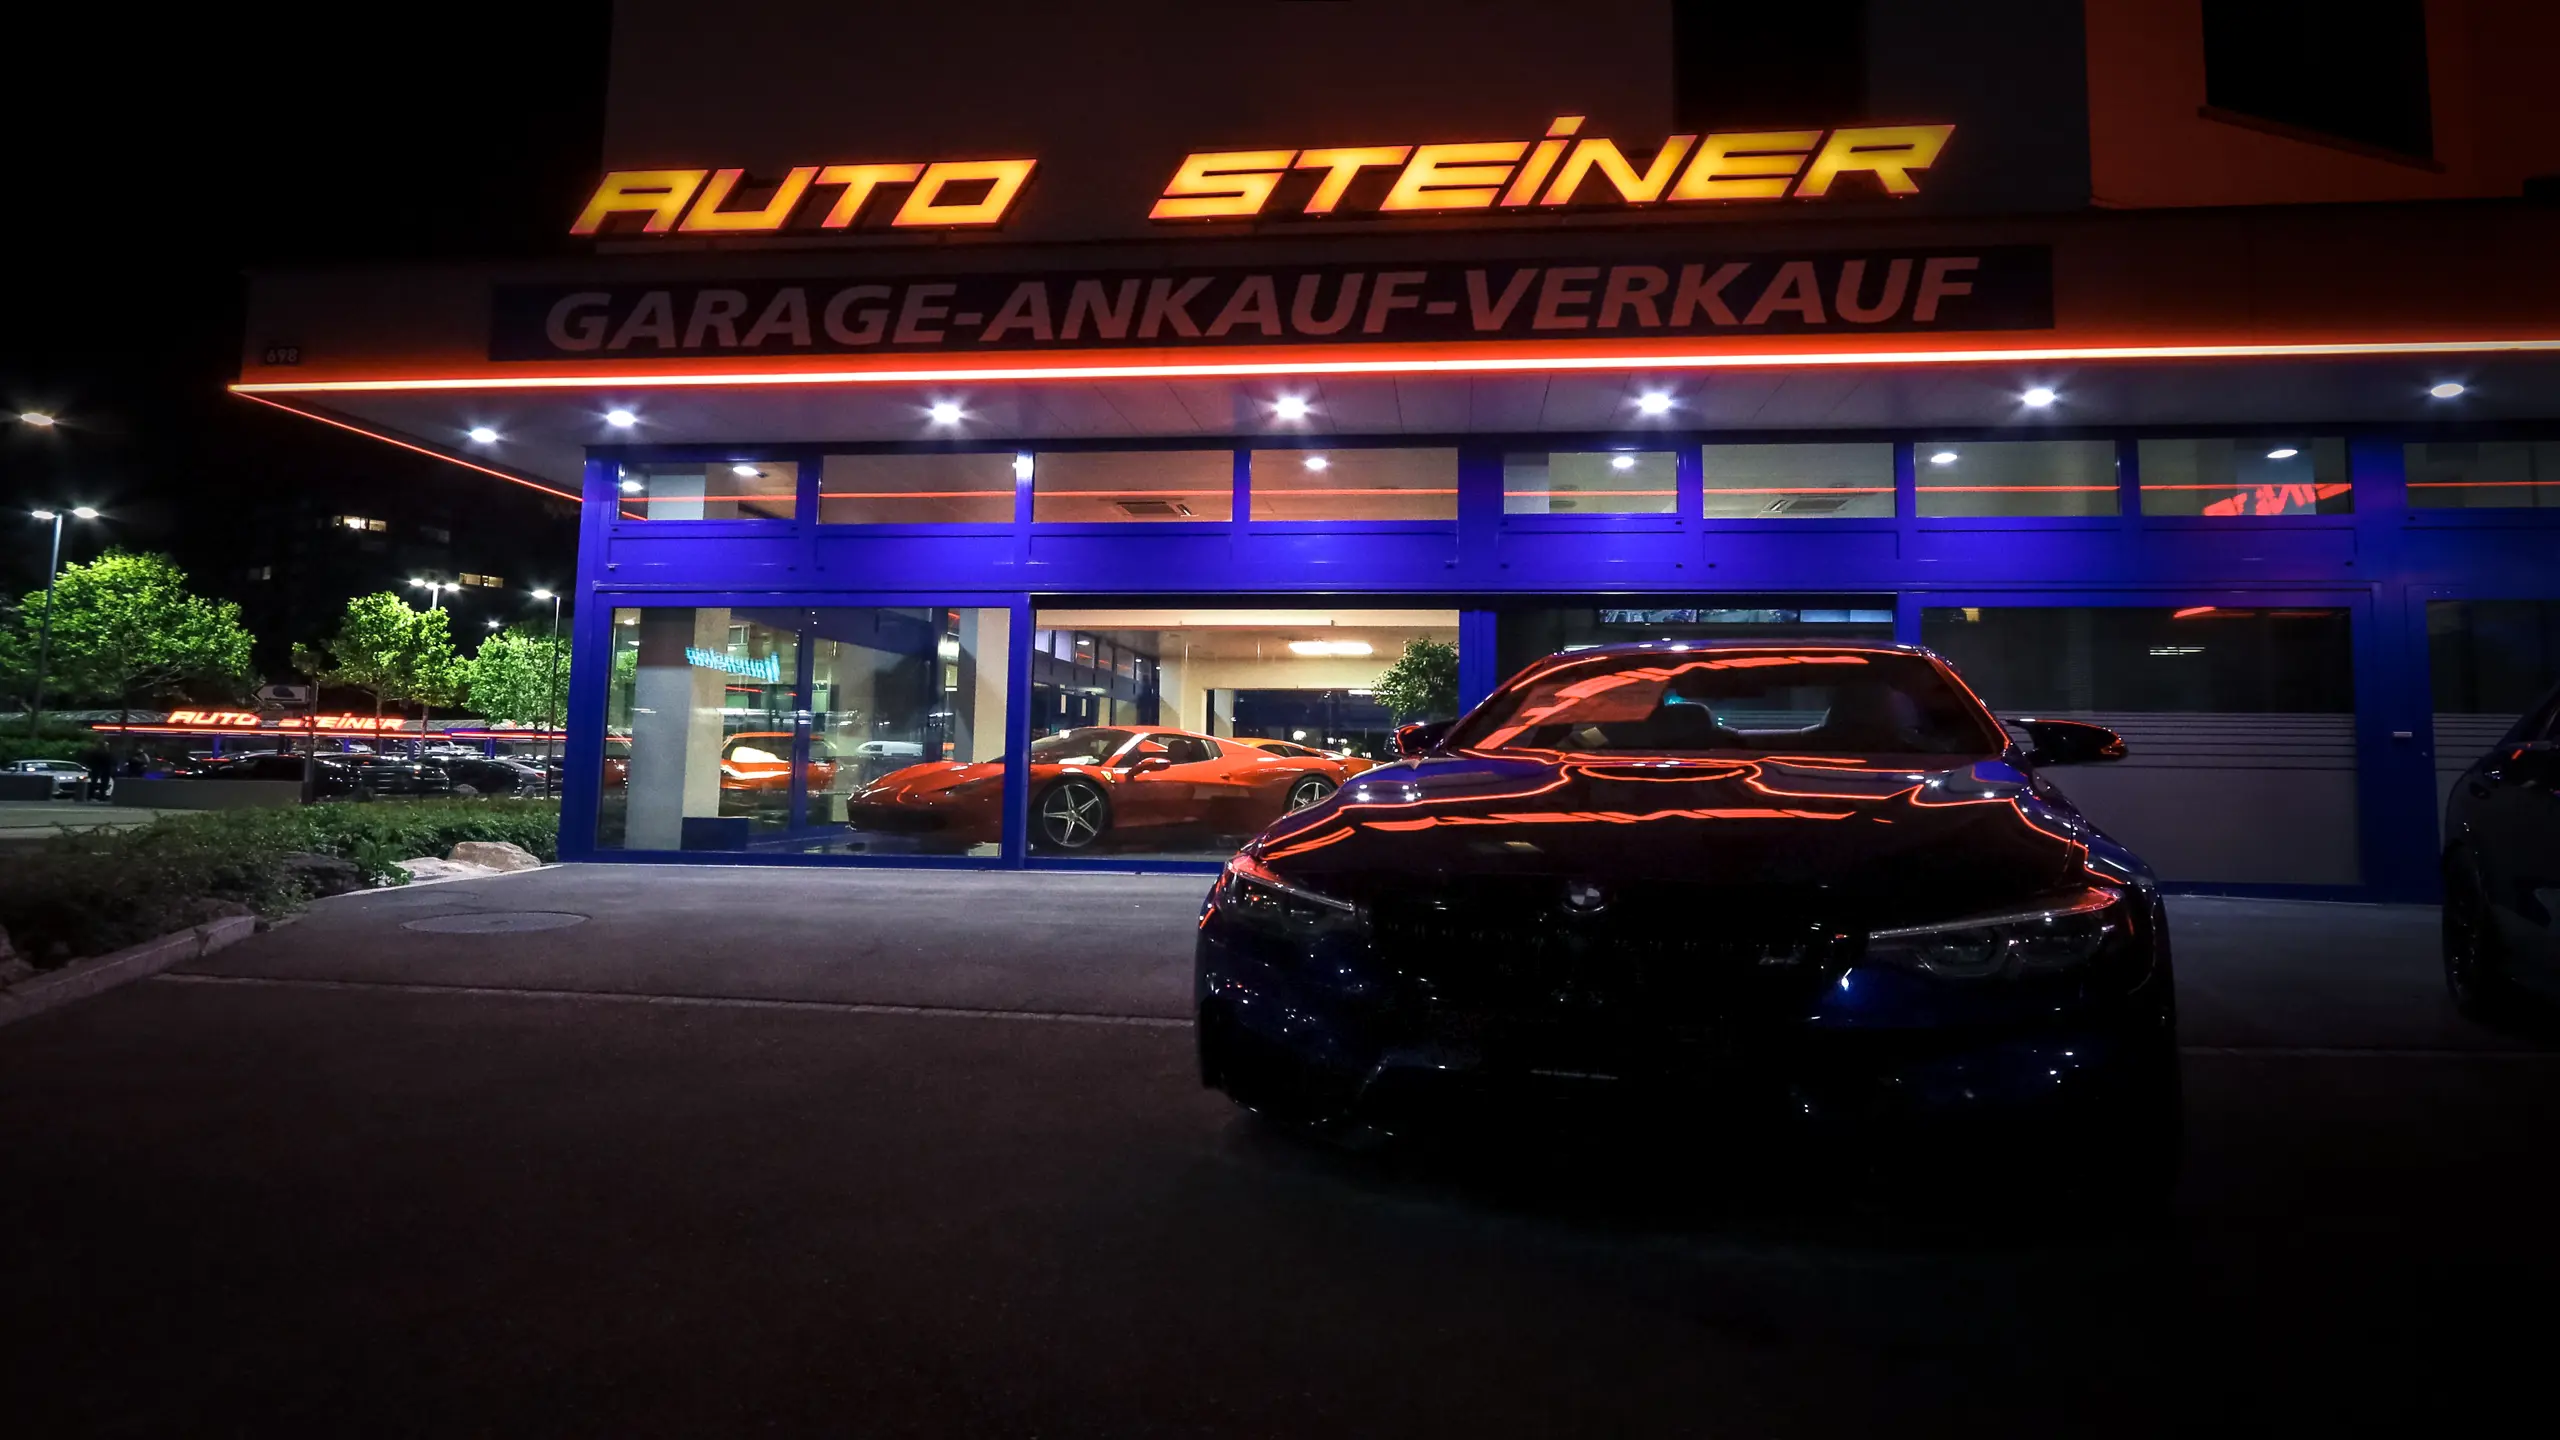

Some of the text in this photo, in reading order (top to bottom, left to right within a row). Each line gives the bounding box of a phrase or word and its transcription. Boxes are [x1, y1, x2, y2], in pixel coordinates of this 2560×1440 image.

[569, 158, 1038, 236] AUTO
[545, 256, 1980, 352] GARAGE-ANKAUF-VERKAUF
[266, 347, 299, 364] 698
[167, 710, 262, 726] AUTO
